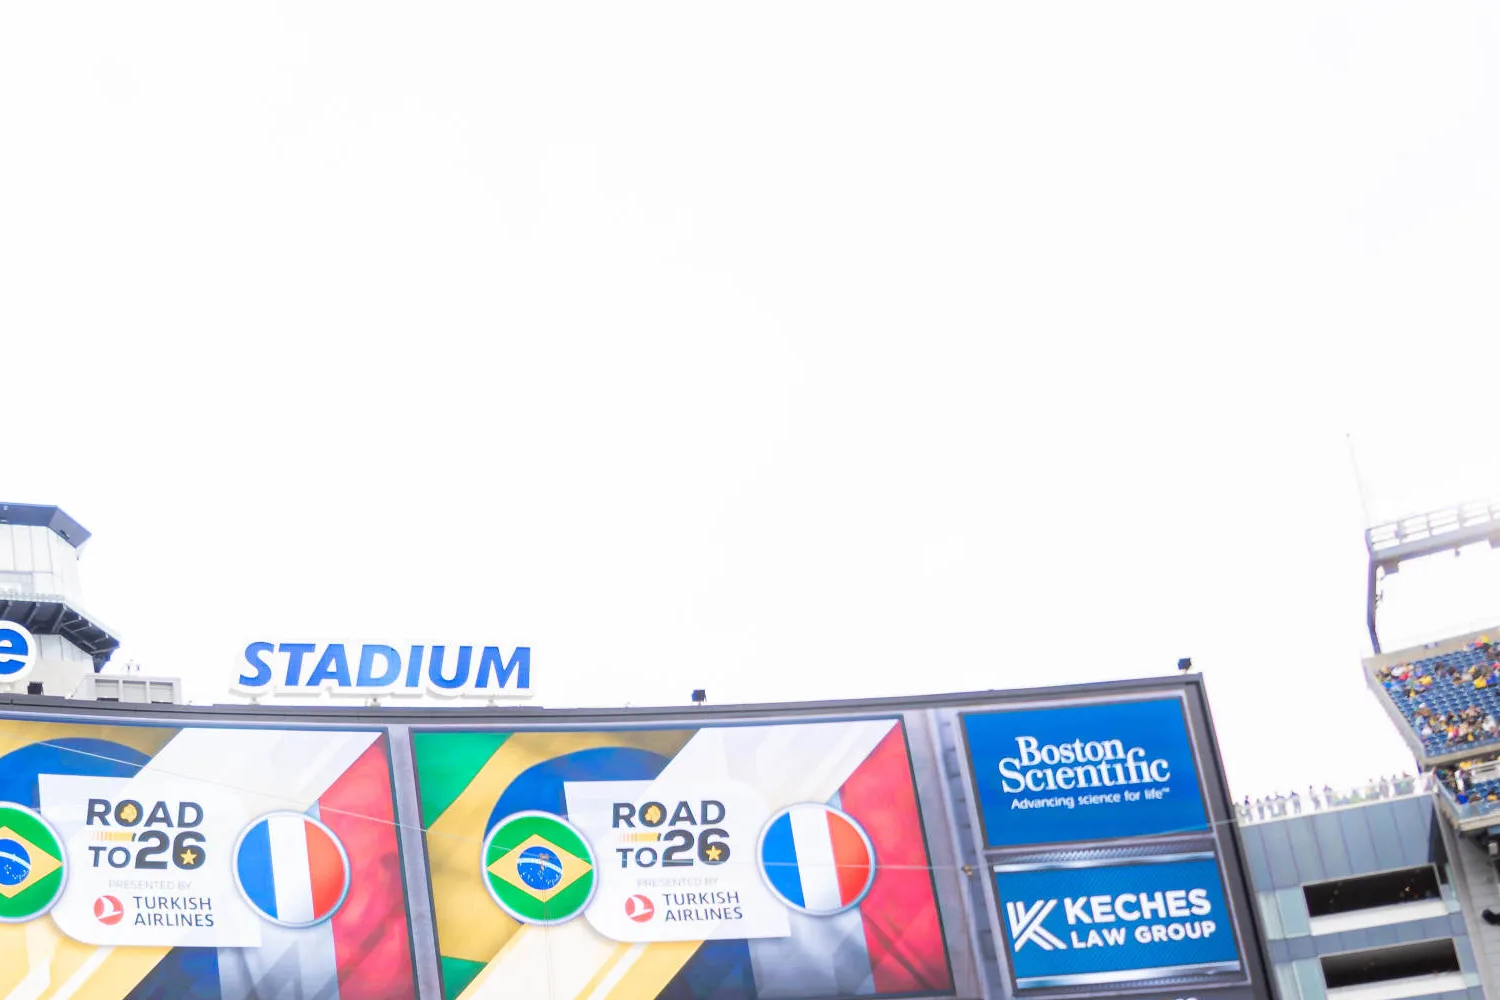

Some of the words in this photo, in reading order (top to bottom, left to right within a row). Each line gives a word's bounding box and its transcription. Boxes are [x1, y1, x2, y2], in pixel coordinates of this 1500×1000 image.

[240, 640, 532, 690] STADIUM
[1014, 735, 1127, 767] Boston
[998, 746, 1172, 794] Scientific
[1010, 796, 1075, 810] Advancing
[1077, 792, 1121, 806] science
[1124, 789, 1141, 802] for
[86, 798, 204, 828] ROAD
[612, 800, 726, 828] ROAD
[88, 846, 131, 869] TO
[616, 847, 658, 868] TO
[108, 878, 175, 890] PRESENTED
[177, 880, 193, 891] BY
[132, 896, 212, 911] TURKISH
[662, 890, 740, 907] TURKISH
[1063, 888, 1213, 925] KECHES
[134, 912, 215, 928] AIRLINES
[665, 906, 744, 922] AIRLINES
[1070, 927, 1127, 949] LAW
[1134, 920, 1217, 945] GROUP
